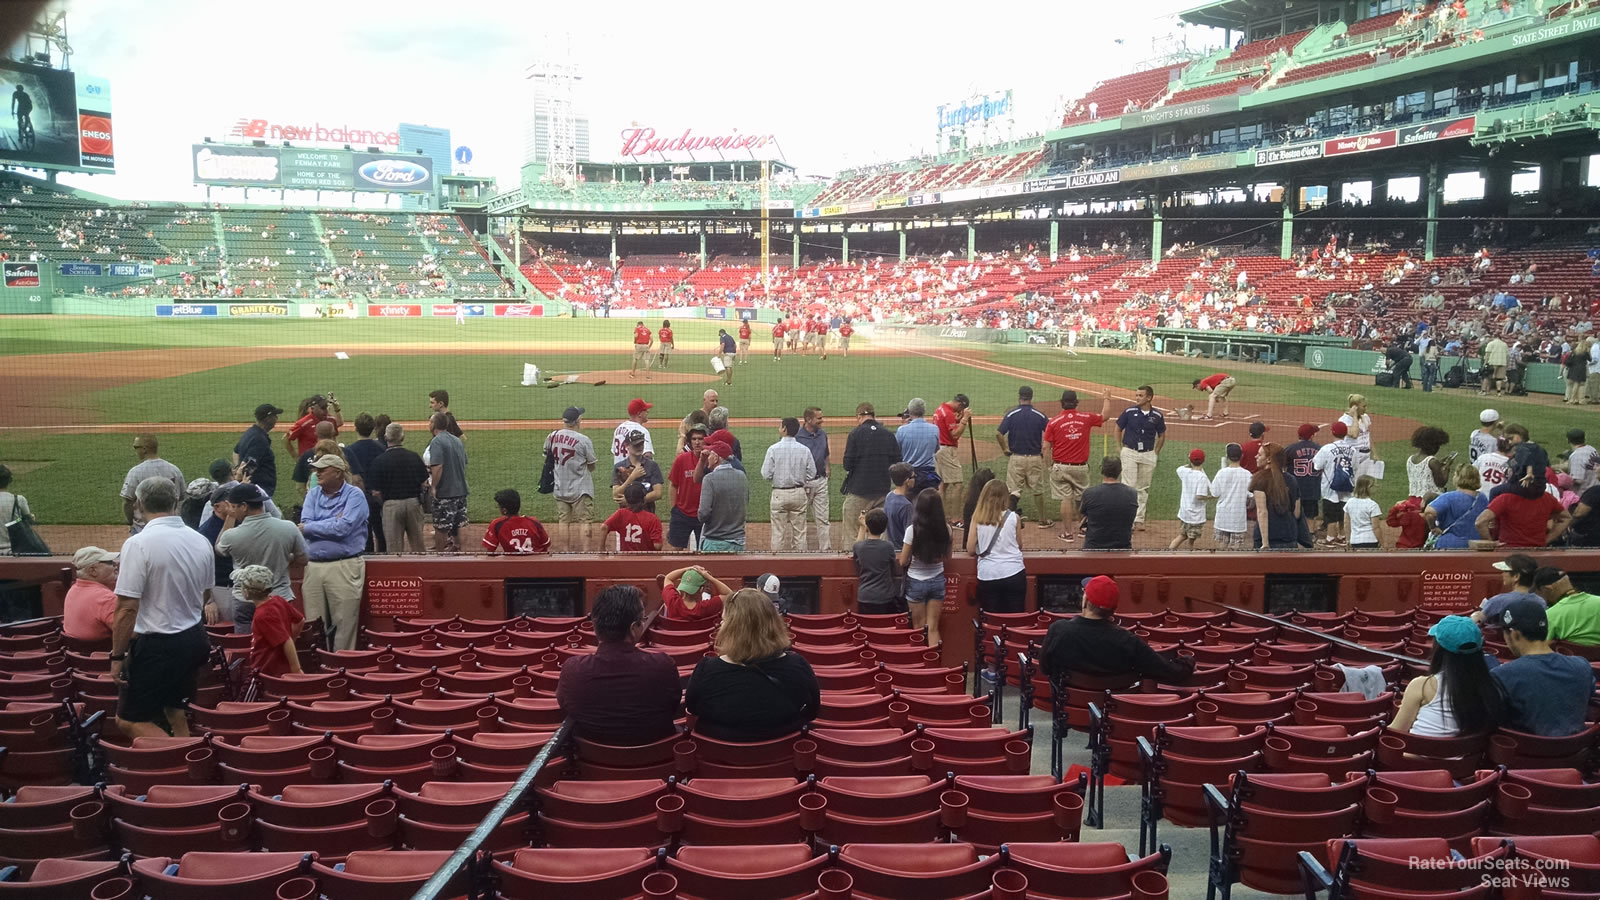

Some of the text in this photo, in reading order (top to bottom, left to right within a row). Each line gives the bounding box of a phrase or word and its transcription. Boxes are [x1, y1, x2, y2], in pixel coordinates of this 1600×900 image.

[1512, 31, 1537, 46] STATE
[1538, 24, 1570, 40] STREET
[1142, 104, 1210, 122] TONIGHT'S STARTERS
[82, 130, 111, 140] ENEOS
[270, 124, 312, 141] new
[316, 122, 400, 145] balance
[1404, 128, 1468, 143] Safelite AutoGlass
[621, 127, 774, 156] Budweiser
[1337, 141, 1357, 150] Ninety
[1368, 137, 1381, 145] Nine
[1268, 152, 1279, 161] The
[1280, 149, 1300, 159] Boston
[1301, 146, 1318, 156] Globe
[372, 163, 415, 182] Ford
[1170, 165, 1178, 173] VS
[1072, 171, 1118, 187] ALEX AND ANI
[114, 266, 135, 275] NESN
[172, 305, 203, 315] jetBlue
[268, 305, 287, 315] CITY
[380, 306, 409, 316] xfinity
[548, 434, 580, 448] MURPHY
[614, 438, 628, 457] 34
[552, 447, 576, 466] 47
[1470, 448, 1477, 464] 9
[1483, 468, 1504, 484] 45
[511, 528, 529, 536] ORTIZ
[625, 523, 643, 543] 12
[509, 537, 534, 552] 34
